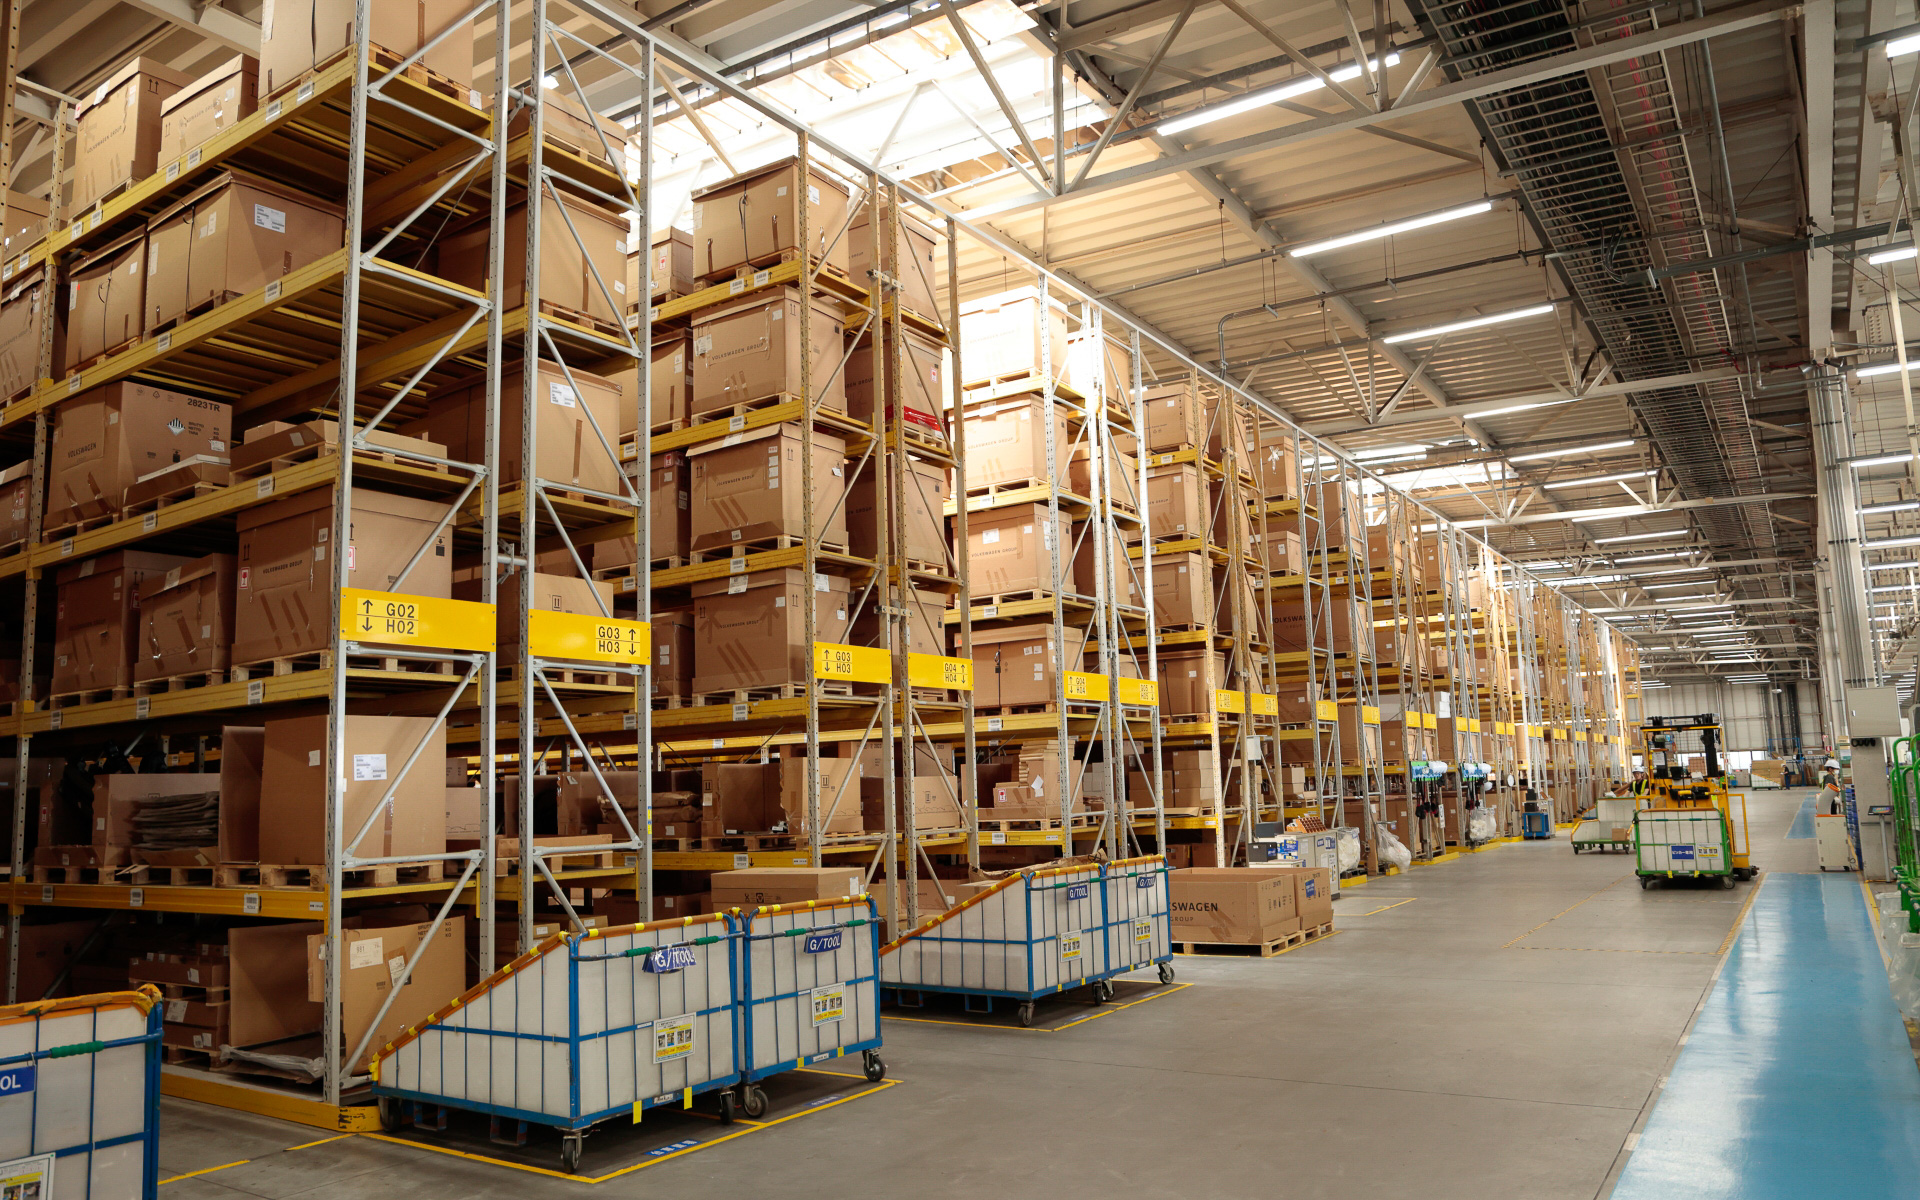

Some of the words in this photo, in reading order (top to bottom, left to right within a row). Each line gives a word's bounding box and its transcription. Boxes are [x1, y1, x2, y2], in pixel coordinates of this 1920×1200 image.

[711, 347, 745, 361] VOLKSWAGEN
[386, 602, 415, 618] G02
[386, 619, 415, 635] H02
[598, 626, 620, 640] G03
[598, 640, 620, 653] H03
[835, 651, 851, 662] G03
[836, 662, 851, 674] H03
[945, 662, 957, 672] G04
[945, 672, 957, 683] H04
[1069, 886, 1088, 899] G/TOOL
[810, 935, 840, 951] G/TOOL
